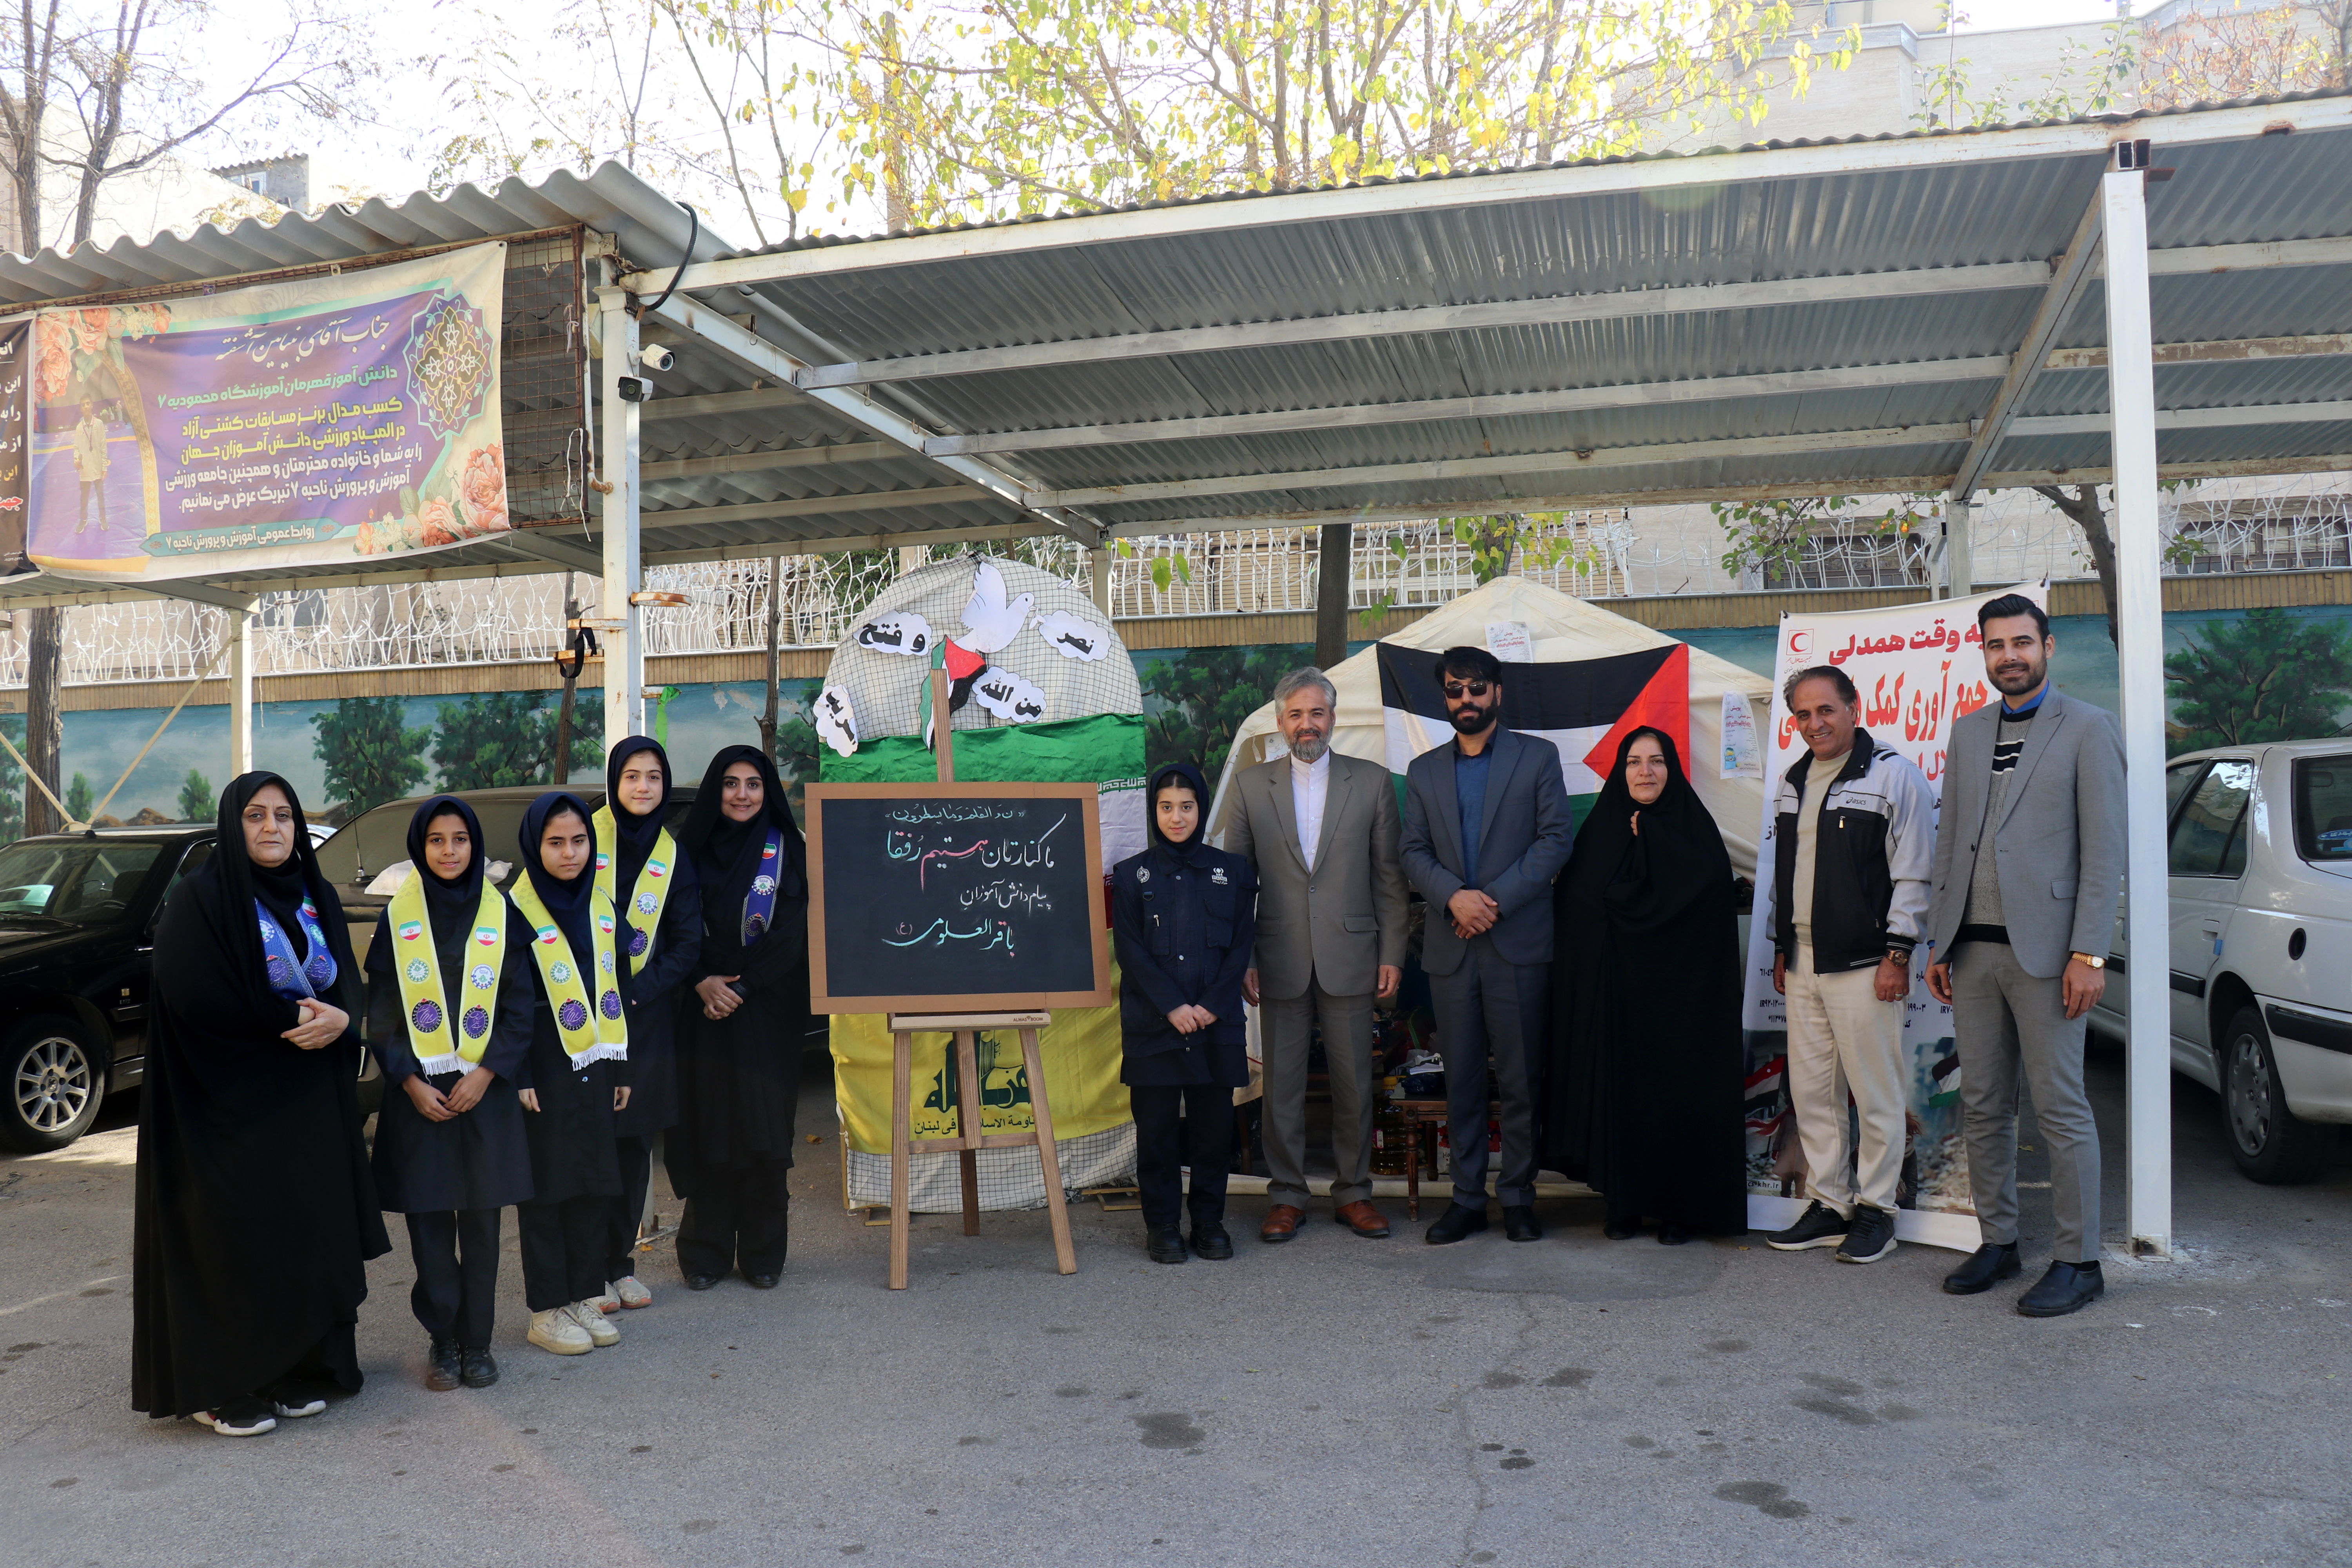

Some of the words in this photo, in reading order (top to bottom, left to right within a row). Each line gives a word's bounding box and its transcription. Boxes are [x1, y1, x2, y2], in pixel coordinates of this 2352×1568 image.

[298, 316, 353, 357] آقای
[341, 315, 390, 353] جناب
[5, 375, 21, 394] این
[284, 373, 331, 397] قهرمان
[331, 365, 358, 389] آموز
[358, 365, 397, 387] دانش
[220, 376, 285, 401] آموزشگاه
[167, 392, 219, 410] محمودیه
[362, 396, 403, 419] کسب
[11, 404, 21, 421] را
[245, 410, 296, 431] مسابقات
[296, 405, 326, 427] برنز
[327, 401, 361, 424] مدال
[182, 416, 200, 439] آزاد
[200, 415, 244, 439] کشتی
[352, 421, 394, 446] المپیاد
[395, 425, 405, 442] در
[10, 434, 22, 452] از
[221, 431, 269, 461] آموزان
[268, 431, 311, 456] دانش
[312, 428, 350, 451] ورزشی
[181, 444, 220, 465] جهان
[330, 449, 372, 472] خانواده
[372, 452, 380, 469] و
[380, 445, 403, 463] شما
[404, 446, 414, 463] به
[415, 442, 422, 462] را
[197, 465, 228, 485] جامعه
[228, 463, 271, 485] همچنین
[272, 463, 279, 479] و
[281, 455, 329, 479] محترمتان
[165, 469, 196, 492] ورزشی
[301, 479, 327, 501] ناحیه
[329, 476, 368, 500] پرورش
[368, 478, 376, 494] و
[376, 464, 412, 494] آموزش
[213, 494, 230, 511] می
[232, 488, 256, 510] عرض
[257, 483, 290, 504] تبریک
[193, 532, 220, 550] پرورش
[221, 535, 227, 548] و
[226, 526, 257, 548] آموزش
[257, 532, 290, 545] عمومی
[290, 524, 315, 539] روابط
[173, 536, 193, 552] ناحیه
[859, 622, 902, 646] فتح
[909, 633, 926, 653] و
[1056, 632, 1094, 655] نصر
[1910, 618, 1960, 653] وقت
[1828, 633, 1905, 666] همدلی
[980, 677, 1014, 703] الله
[1865, 671, 1905, 728] کمک
[1905, 659, 1951, 742] آوری
[1015, 697, 1042, 718] من
[920, 835, 989, 893] هستیم
[998, 882, 1028, 908] دانش
[1028, 884, 1052, 918] پیام
[915, 1120, 940, 1134] لبنان
[1748, 1181, 1779, 1189] cs-khr.ir
